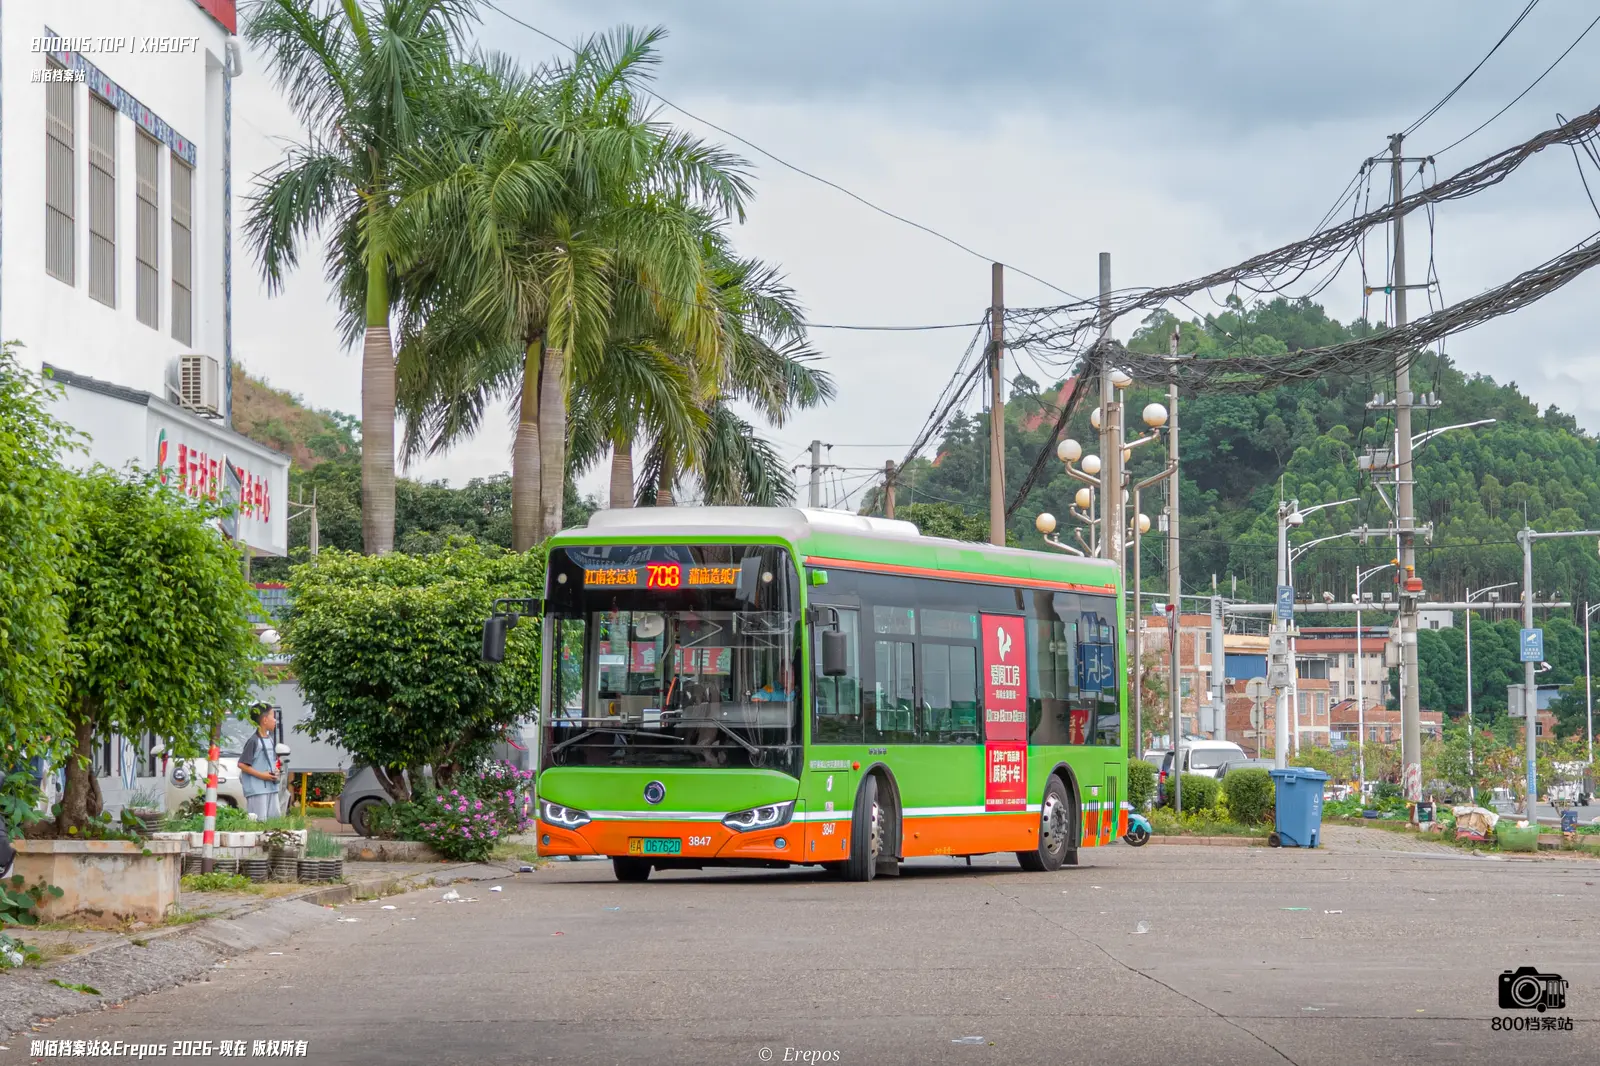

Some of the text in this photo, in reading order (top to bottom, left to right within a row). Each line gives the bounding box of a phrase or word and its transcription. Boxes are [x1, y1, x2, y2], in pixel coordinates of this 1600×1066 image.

[585, 565, 742, 587] 江南客运站 708 蒲庙造纸厂
[993, 765, 1020, 783] 质保十年
[822, 822, 836, 835] 3847
[688, 836, 711, 846] 3847
